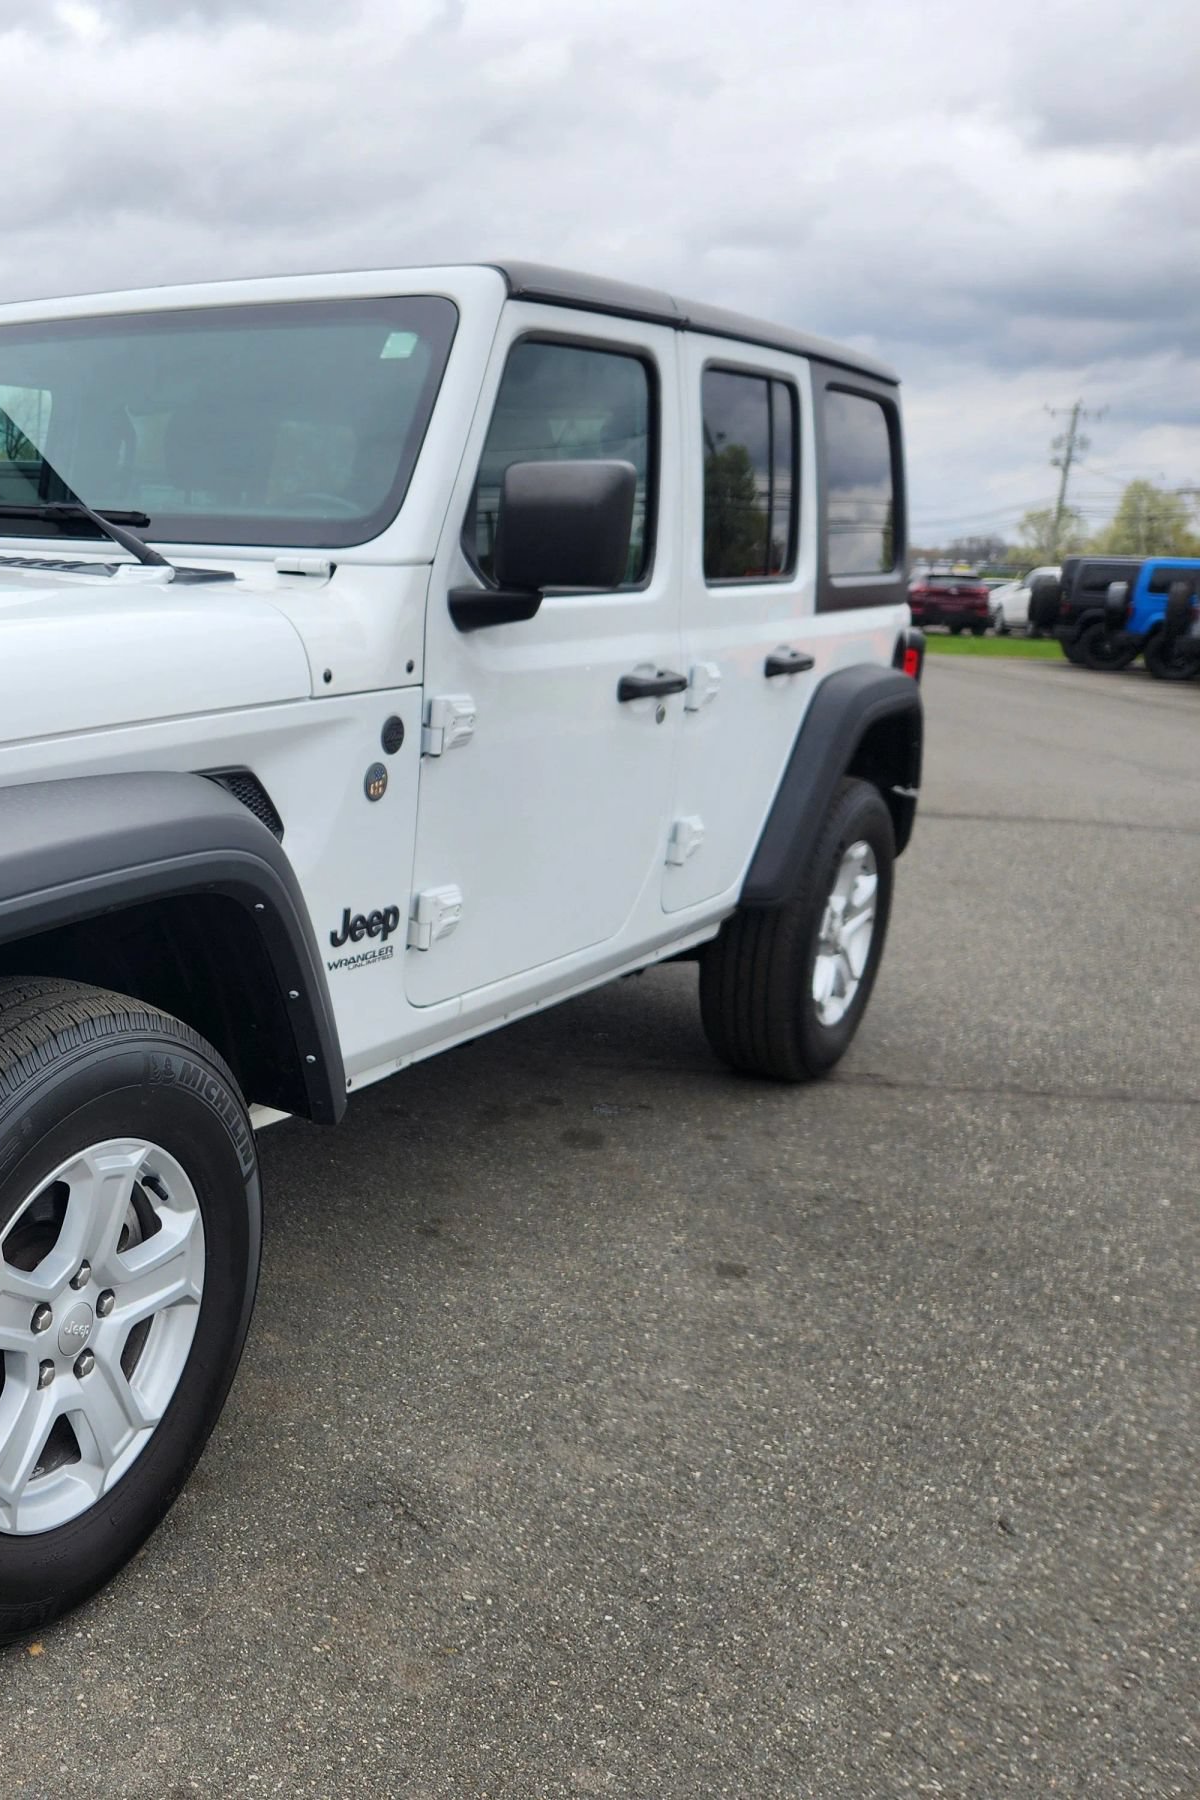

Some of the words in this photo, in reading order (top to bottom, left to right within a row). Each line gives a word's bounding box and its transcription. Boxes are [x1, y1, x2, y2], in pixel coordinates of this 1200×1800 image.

[329, 904, 400, 949] Jeep
[327, 945, 394, 972] WRANGLER
[347, 953, 394, 972] UNLIMITED
[178, 1061, 255, 1167] MICHELIN
[64, 1320, 91, 1339] Jeep
